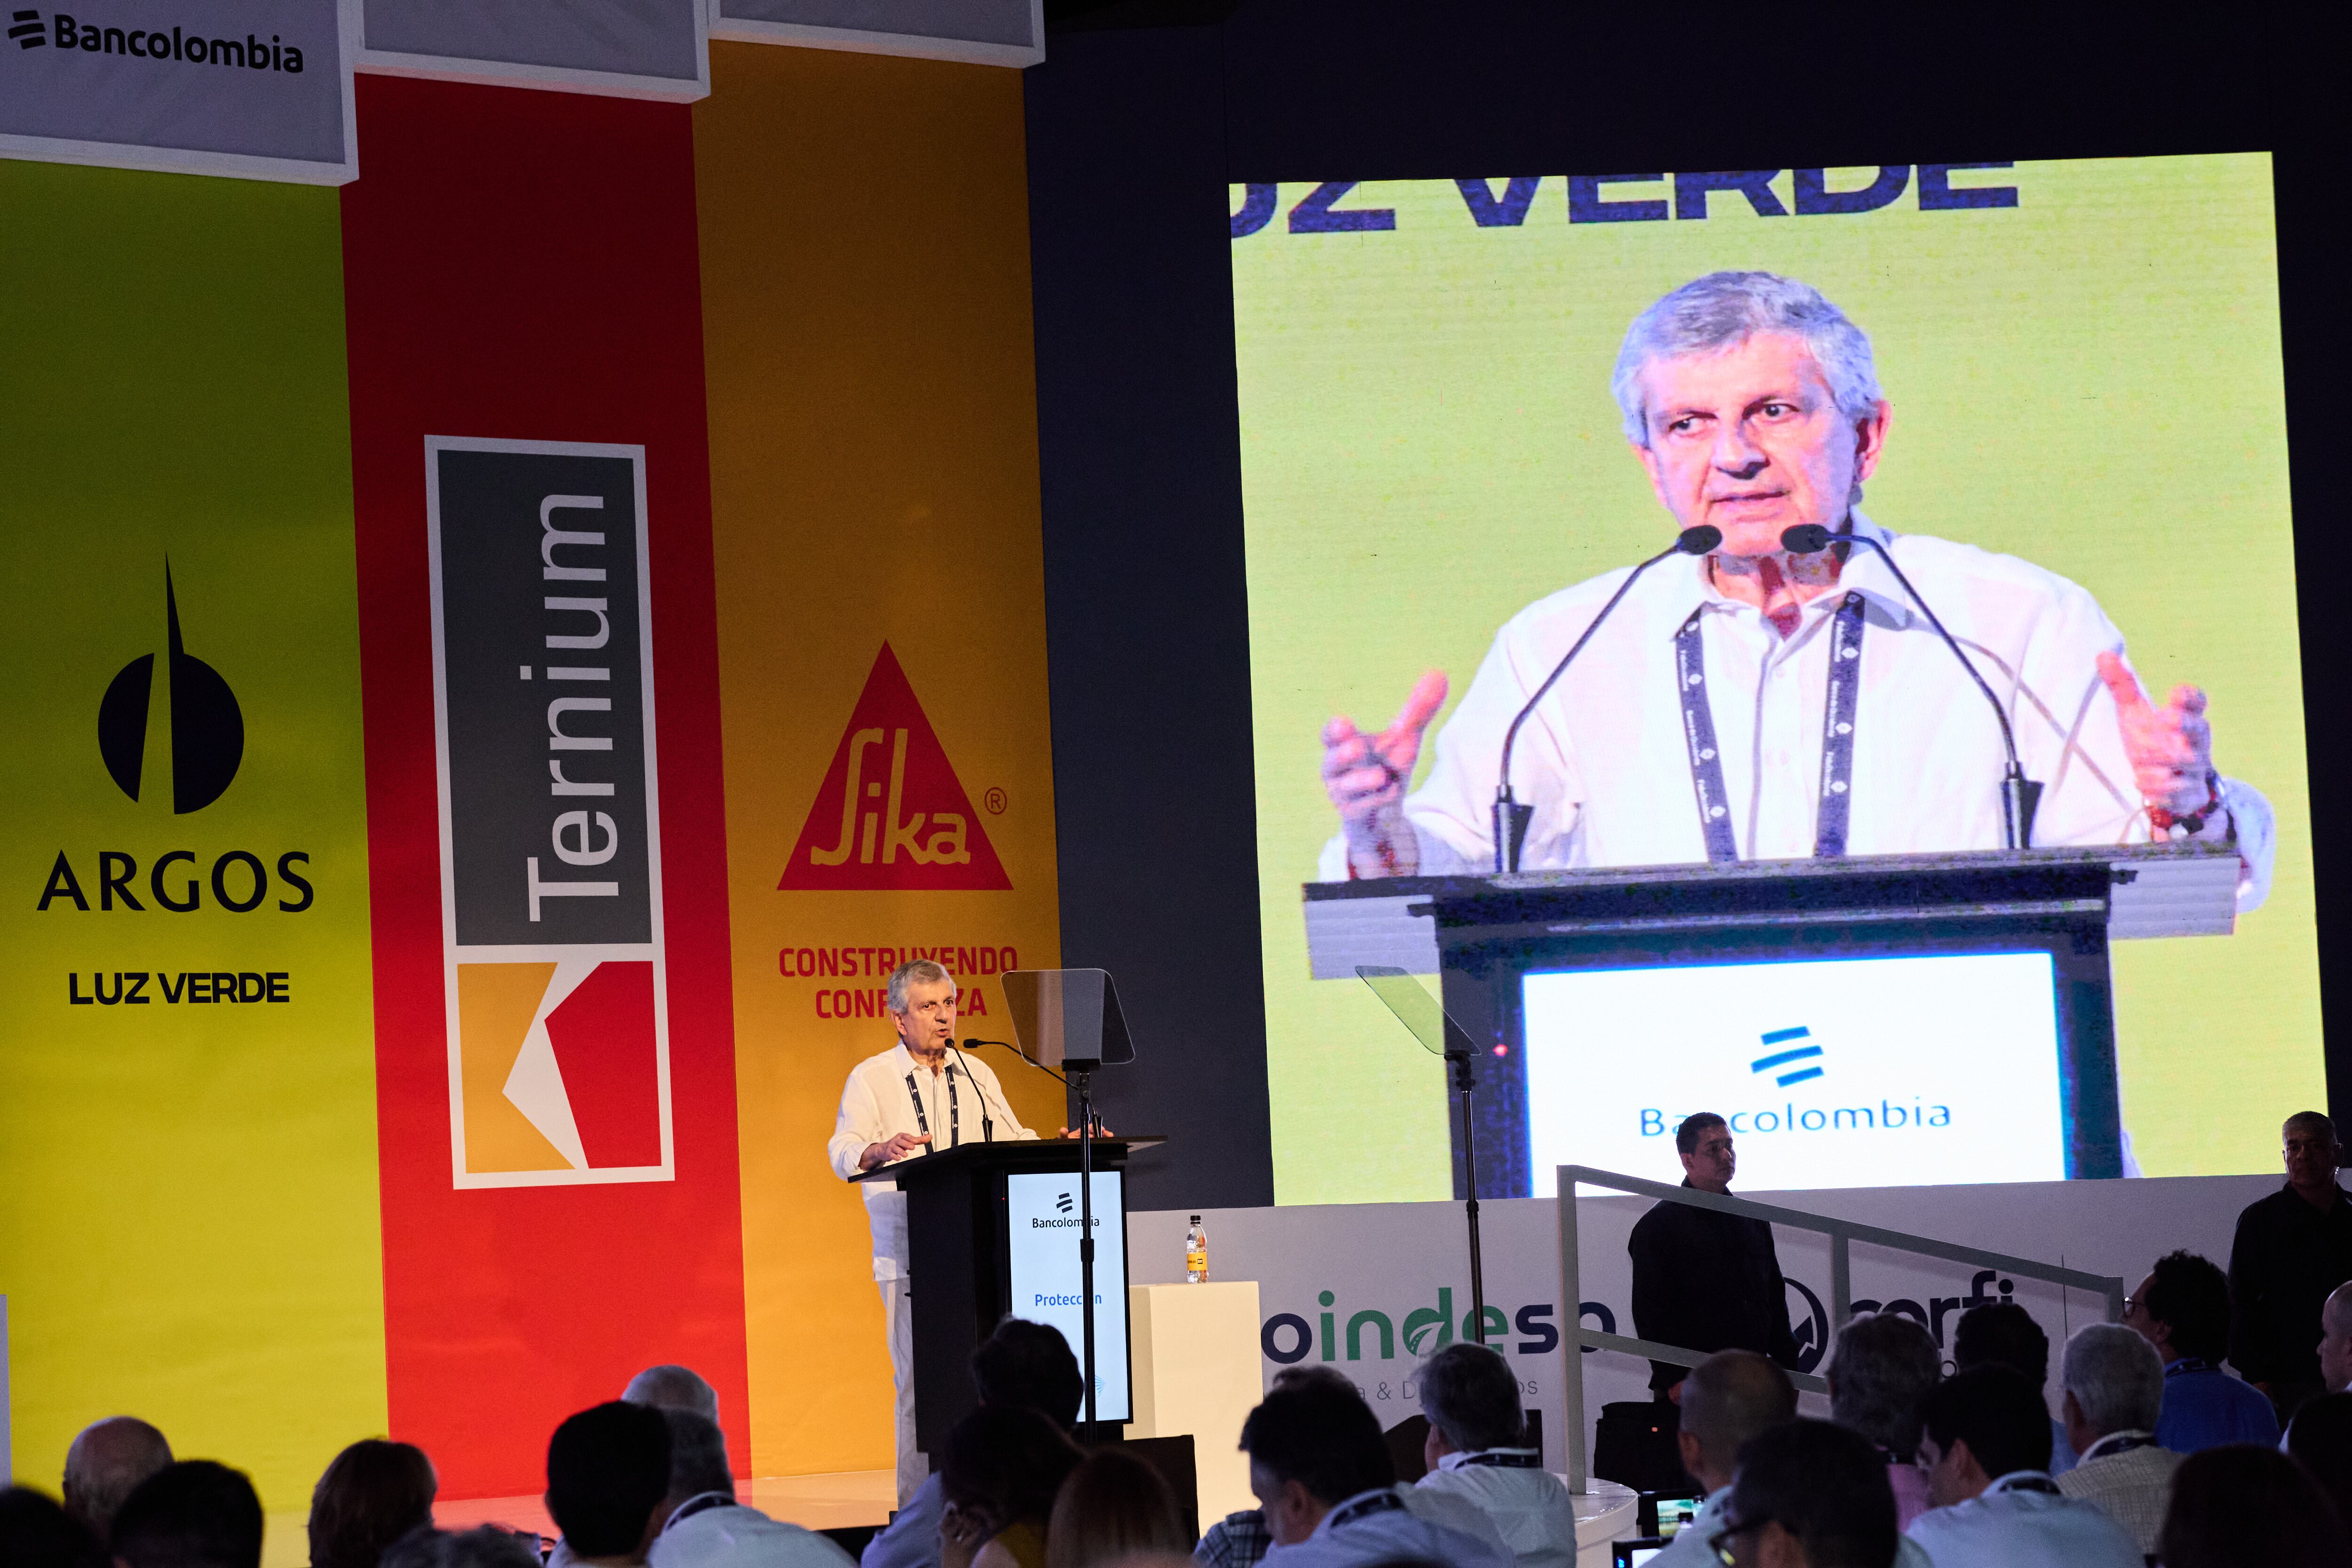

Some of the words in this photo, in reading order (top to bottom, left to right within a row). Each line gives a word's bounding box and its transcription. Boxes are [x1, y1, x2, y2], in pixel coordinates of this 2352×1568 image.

[55, 14, 303, 73] Bancolombia
[519, 494, 619, 922] Ternium
[810, 727, 971, 866] Sika
[37, 849, 314, 913] ARGOS
[69, 972, 150, 1005] LUZ
[157, 972, 290, 1003] VERDE
[816, 988, 987, 1019] CONFZA
[1640, 1097, 1951, 1137] Bcolombia
[1033, 1216, 1100, 1228] Bancolomia
[1035, 1294, 1102, 1306] Proteccn
